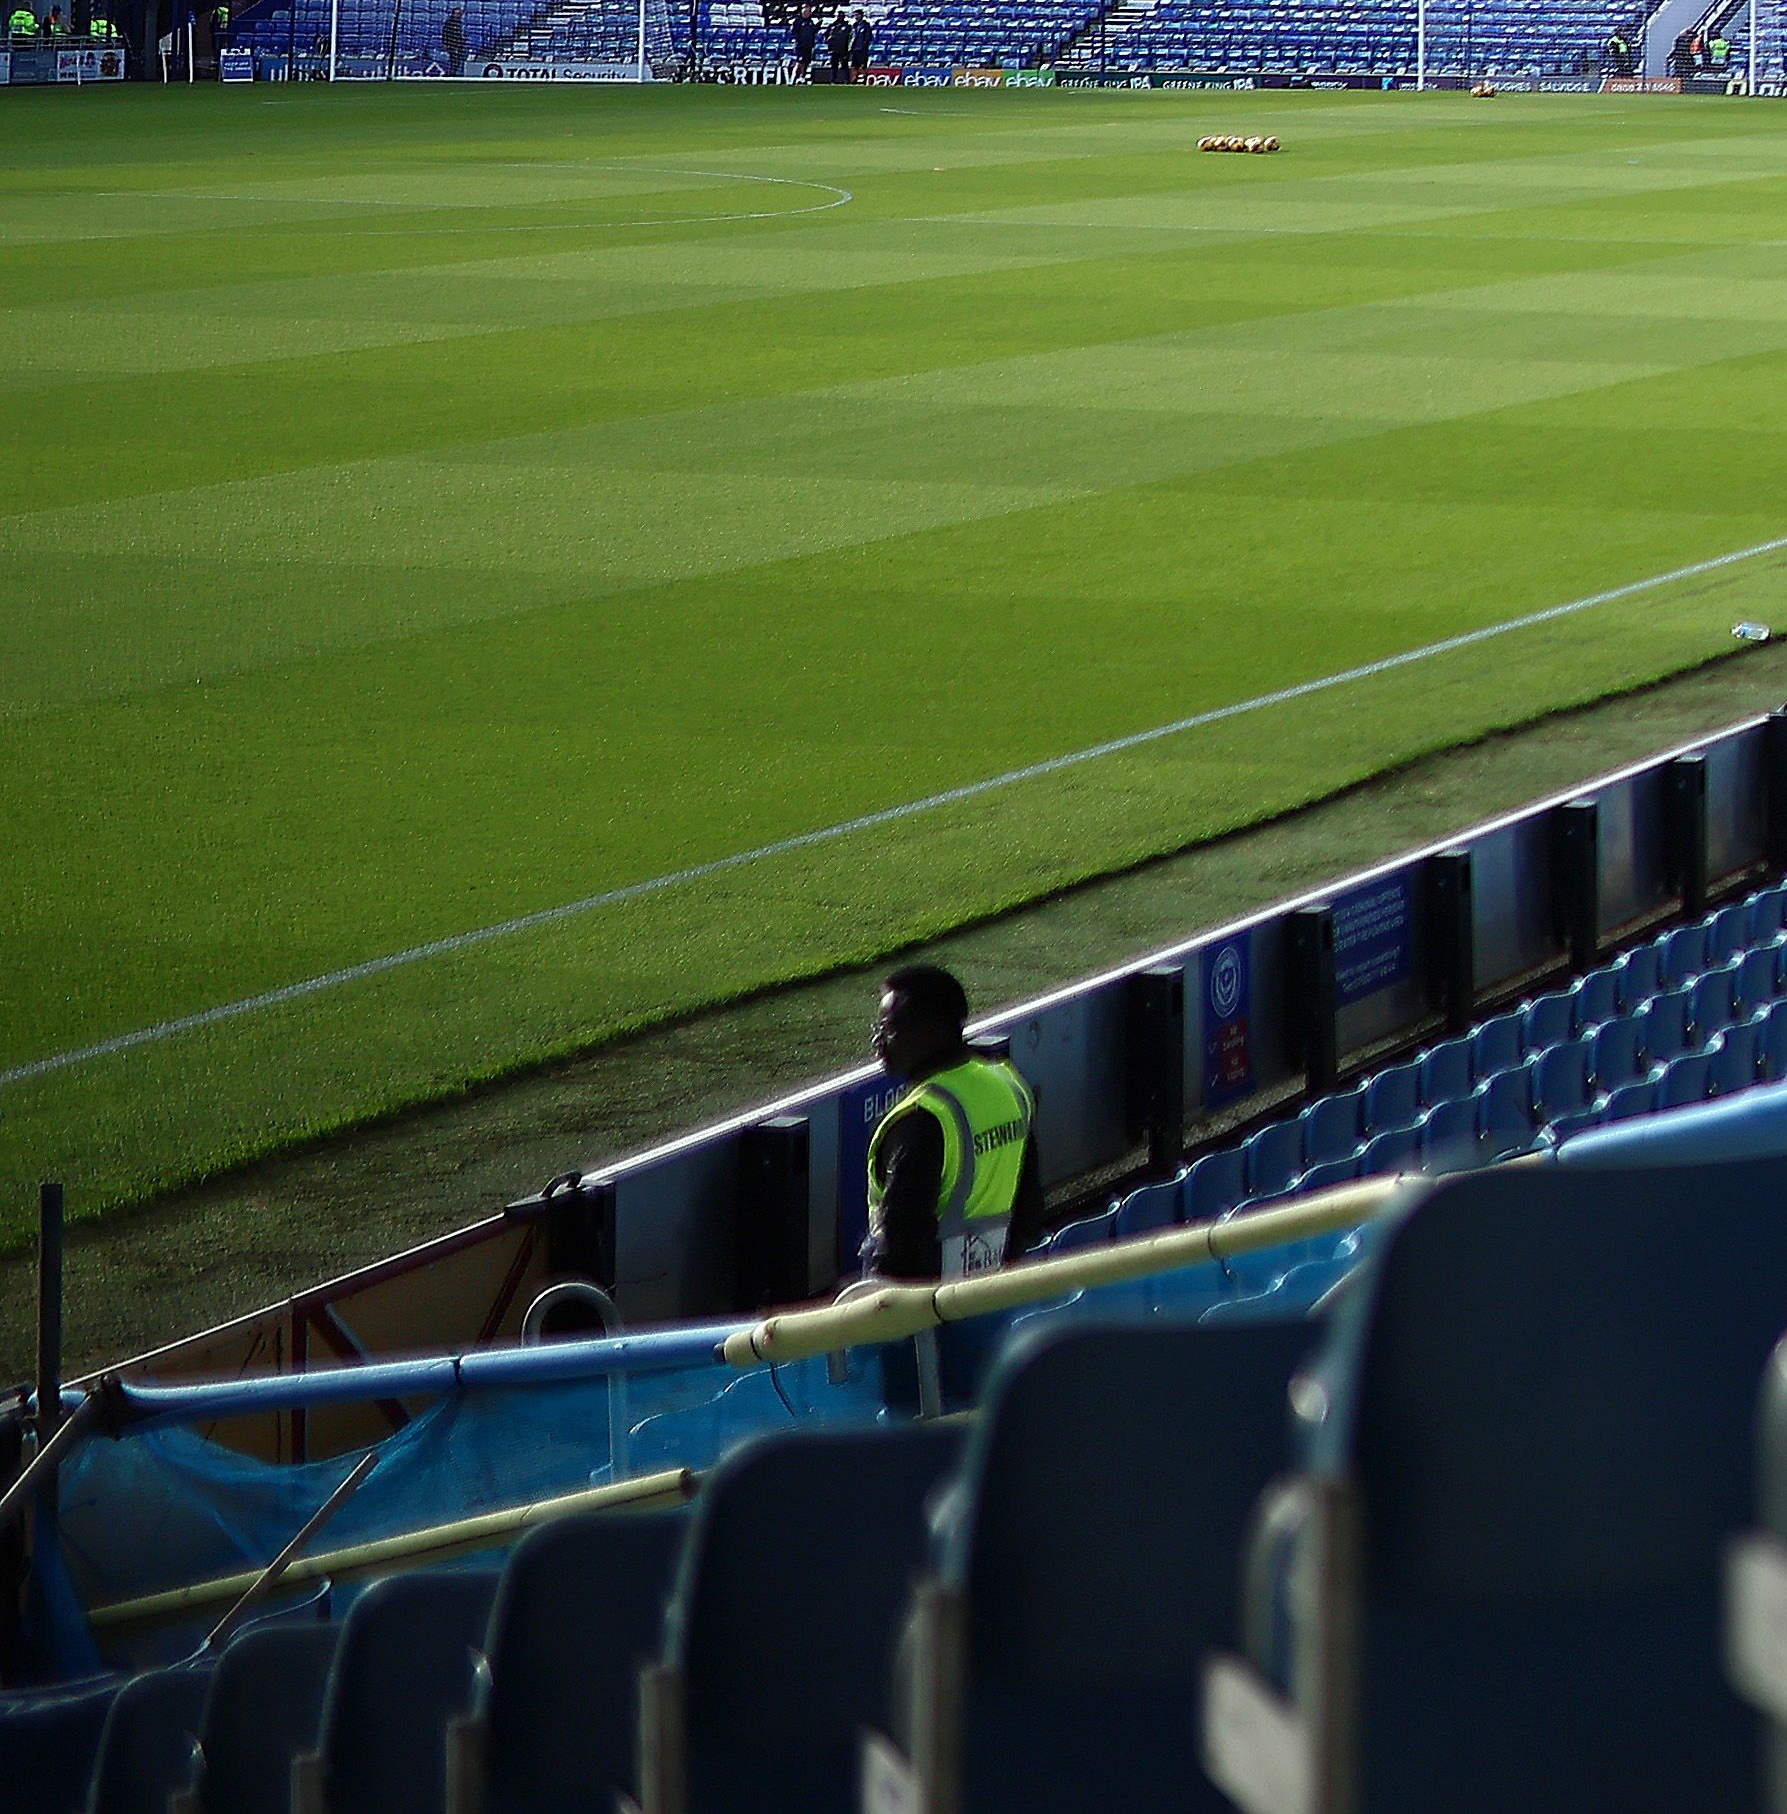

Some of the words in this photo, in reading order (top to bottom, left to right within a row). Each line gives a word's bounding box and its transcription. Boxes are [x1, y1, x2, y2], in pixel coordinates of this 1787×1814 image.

[904, 68, 951, 86] ebay
[955, 70, 1000, 87] ebay
[1006, 71, 1053, 88] ebay
[1130, 75, 1152, 90] IPA
[1232, 77, 1255, 91] IPA
